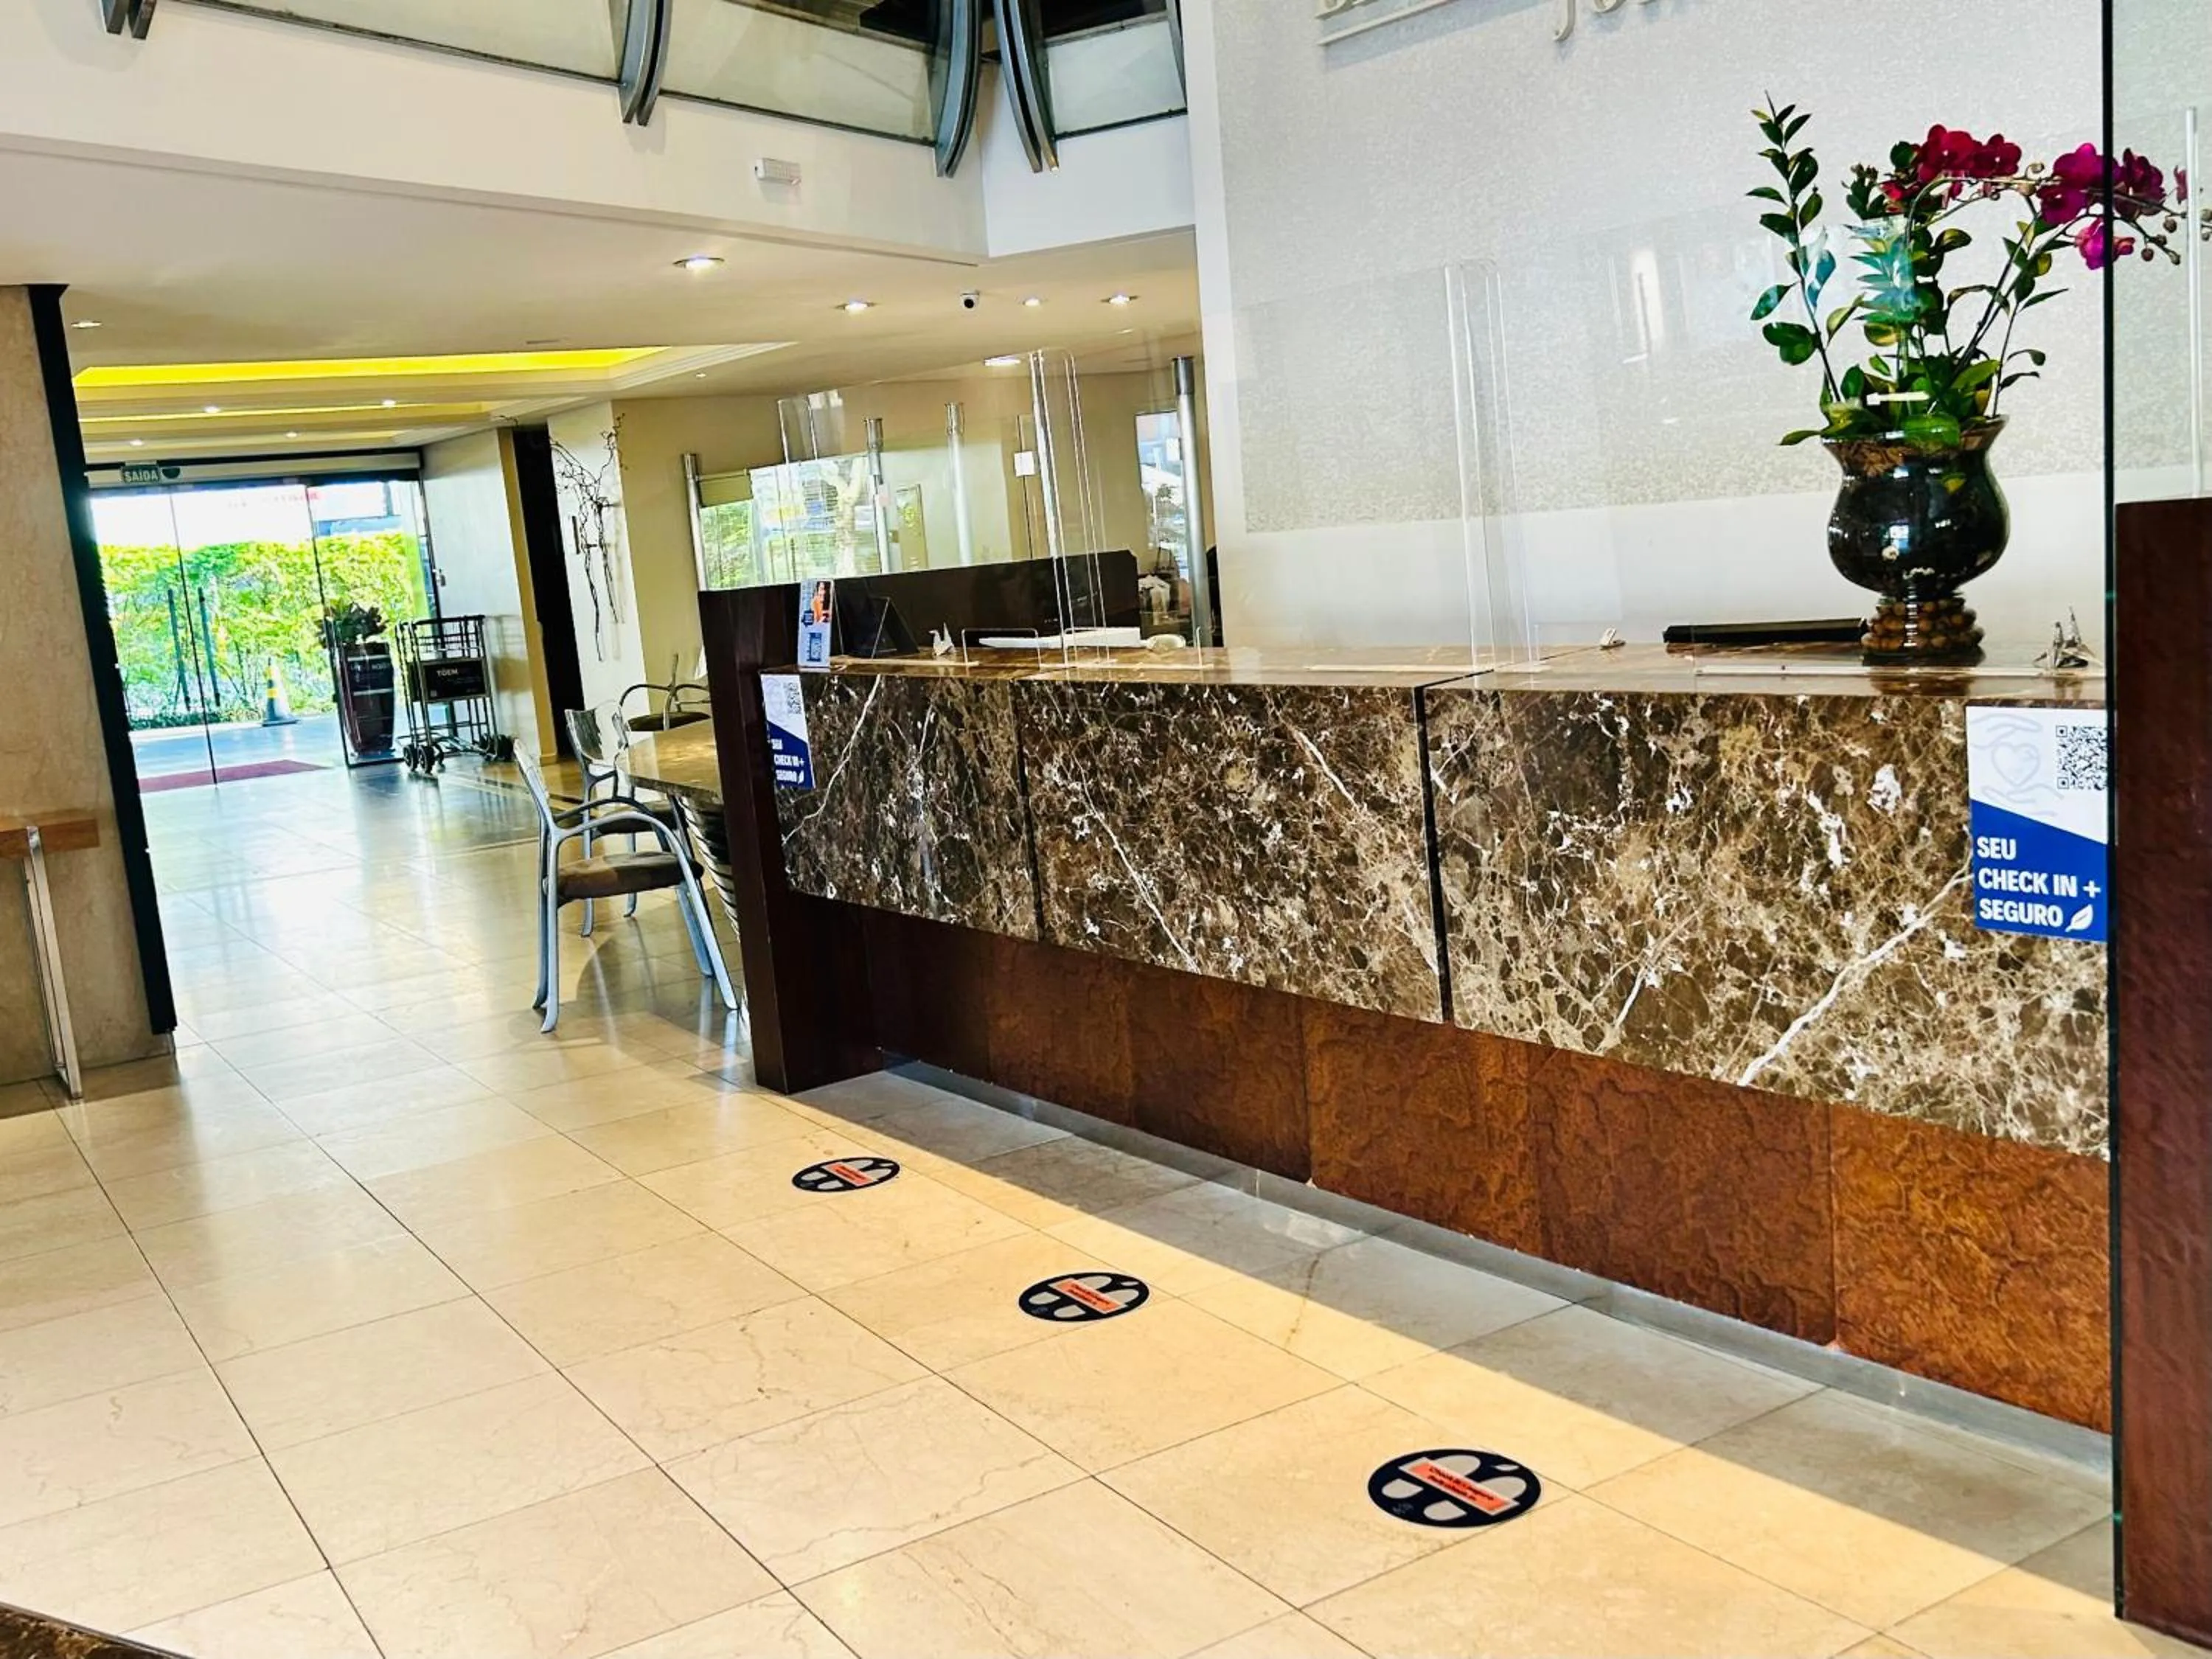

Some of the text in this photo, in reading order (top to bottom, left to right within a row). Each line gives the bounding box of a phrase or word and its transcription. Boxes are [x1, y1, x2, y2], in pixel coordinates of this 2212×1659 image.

[124, 468, 159, 483] SAÍDA
[1976, 836, 2017, 860] SEU
[1978, 868, 2049, 895] CHECK
[2053, 874, 2078, 897] IN
[1979, 899, 2064, 928] SEGURO
